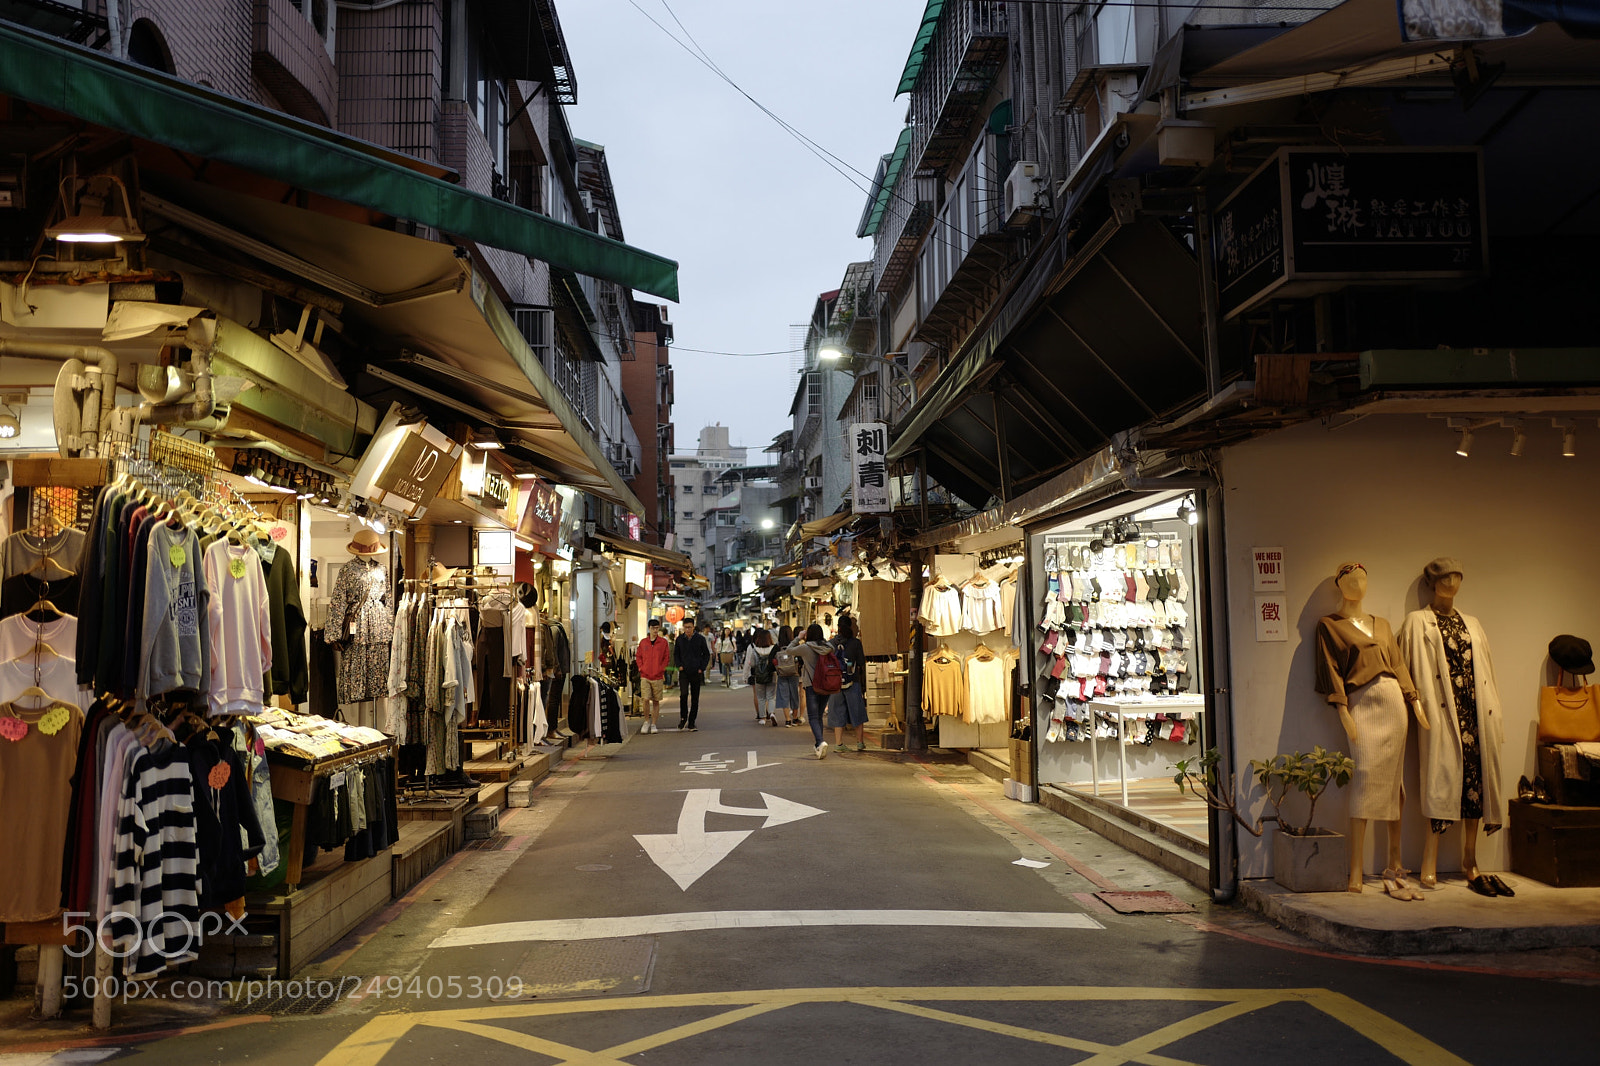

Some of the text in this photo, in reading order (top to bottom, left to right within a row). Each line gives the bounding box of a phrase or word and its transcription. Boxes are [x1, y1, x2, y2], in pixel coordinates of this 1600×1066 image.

[1370, 219, 1472, 238] TATTOO
[857, 428, 884, 488] 刺青
[1255, 552, 1282, 561] WE NEED
[1261, 602, 1281, 622] 徵
